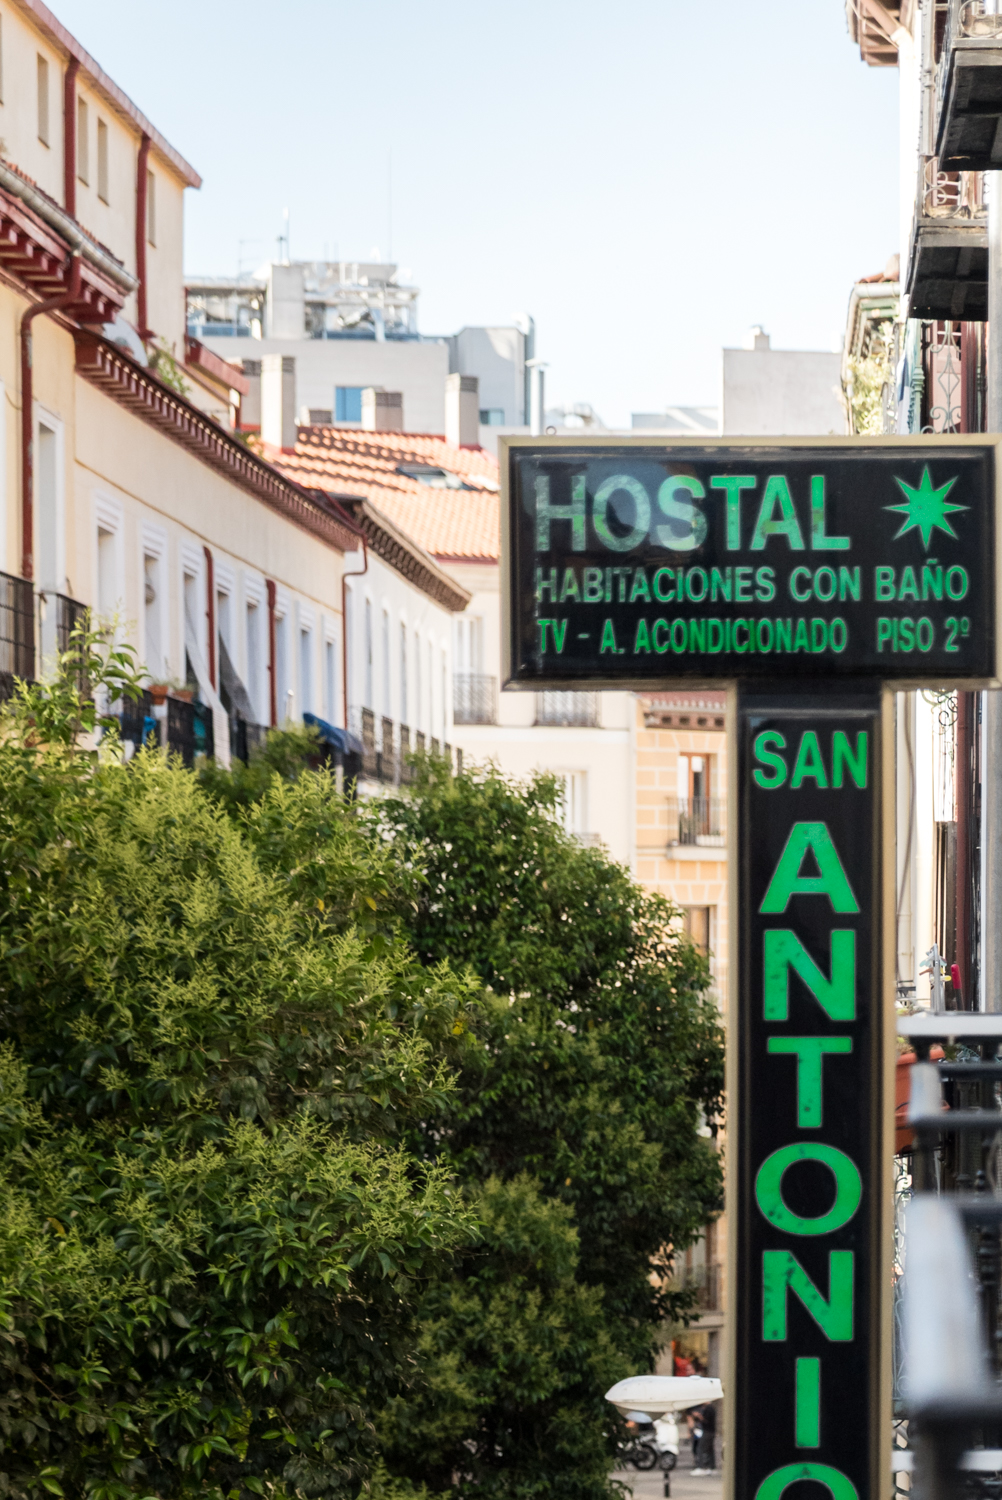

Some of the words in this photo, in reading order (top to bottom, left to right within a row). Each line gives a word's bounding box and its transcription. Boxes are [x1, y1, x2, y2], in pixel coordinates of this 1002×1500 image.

[535, 475, 850, 551] HOSTAL
[536, 566, 776, 602] HABITACIONES
[789, 566, 861, 601] CON
[875, 558, 969, 601] BAÑO
[537, 618, 568, 653] TV
[633, 617, 848, 653] ACONDICIONADO
[876, 616, 934, 652] PISO
[753, 731, 868, 788] SAN
